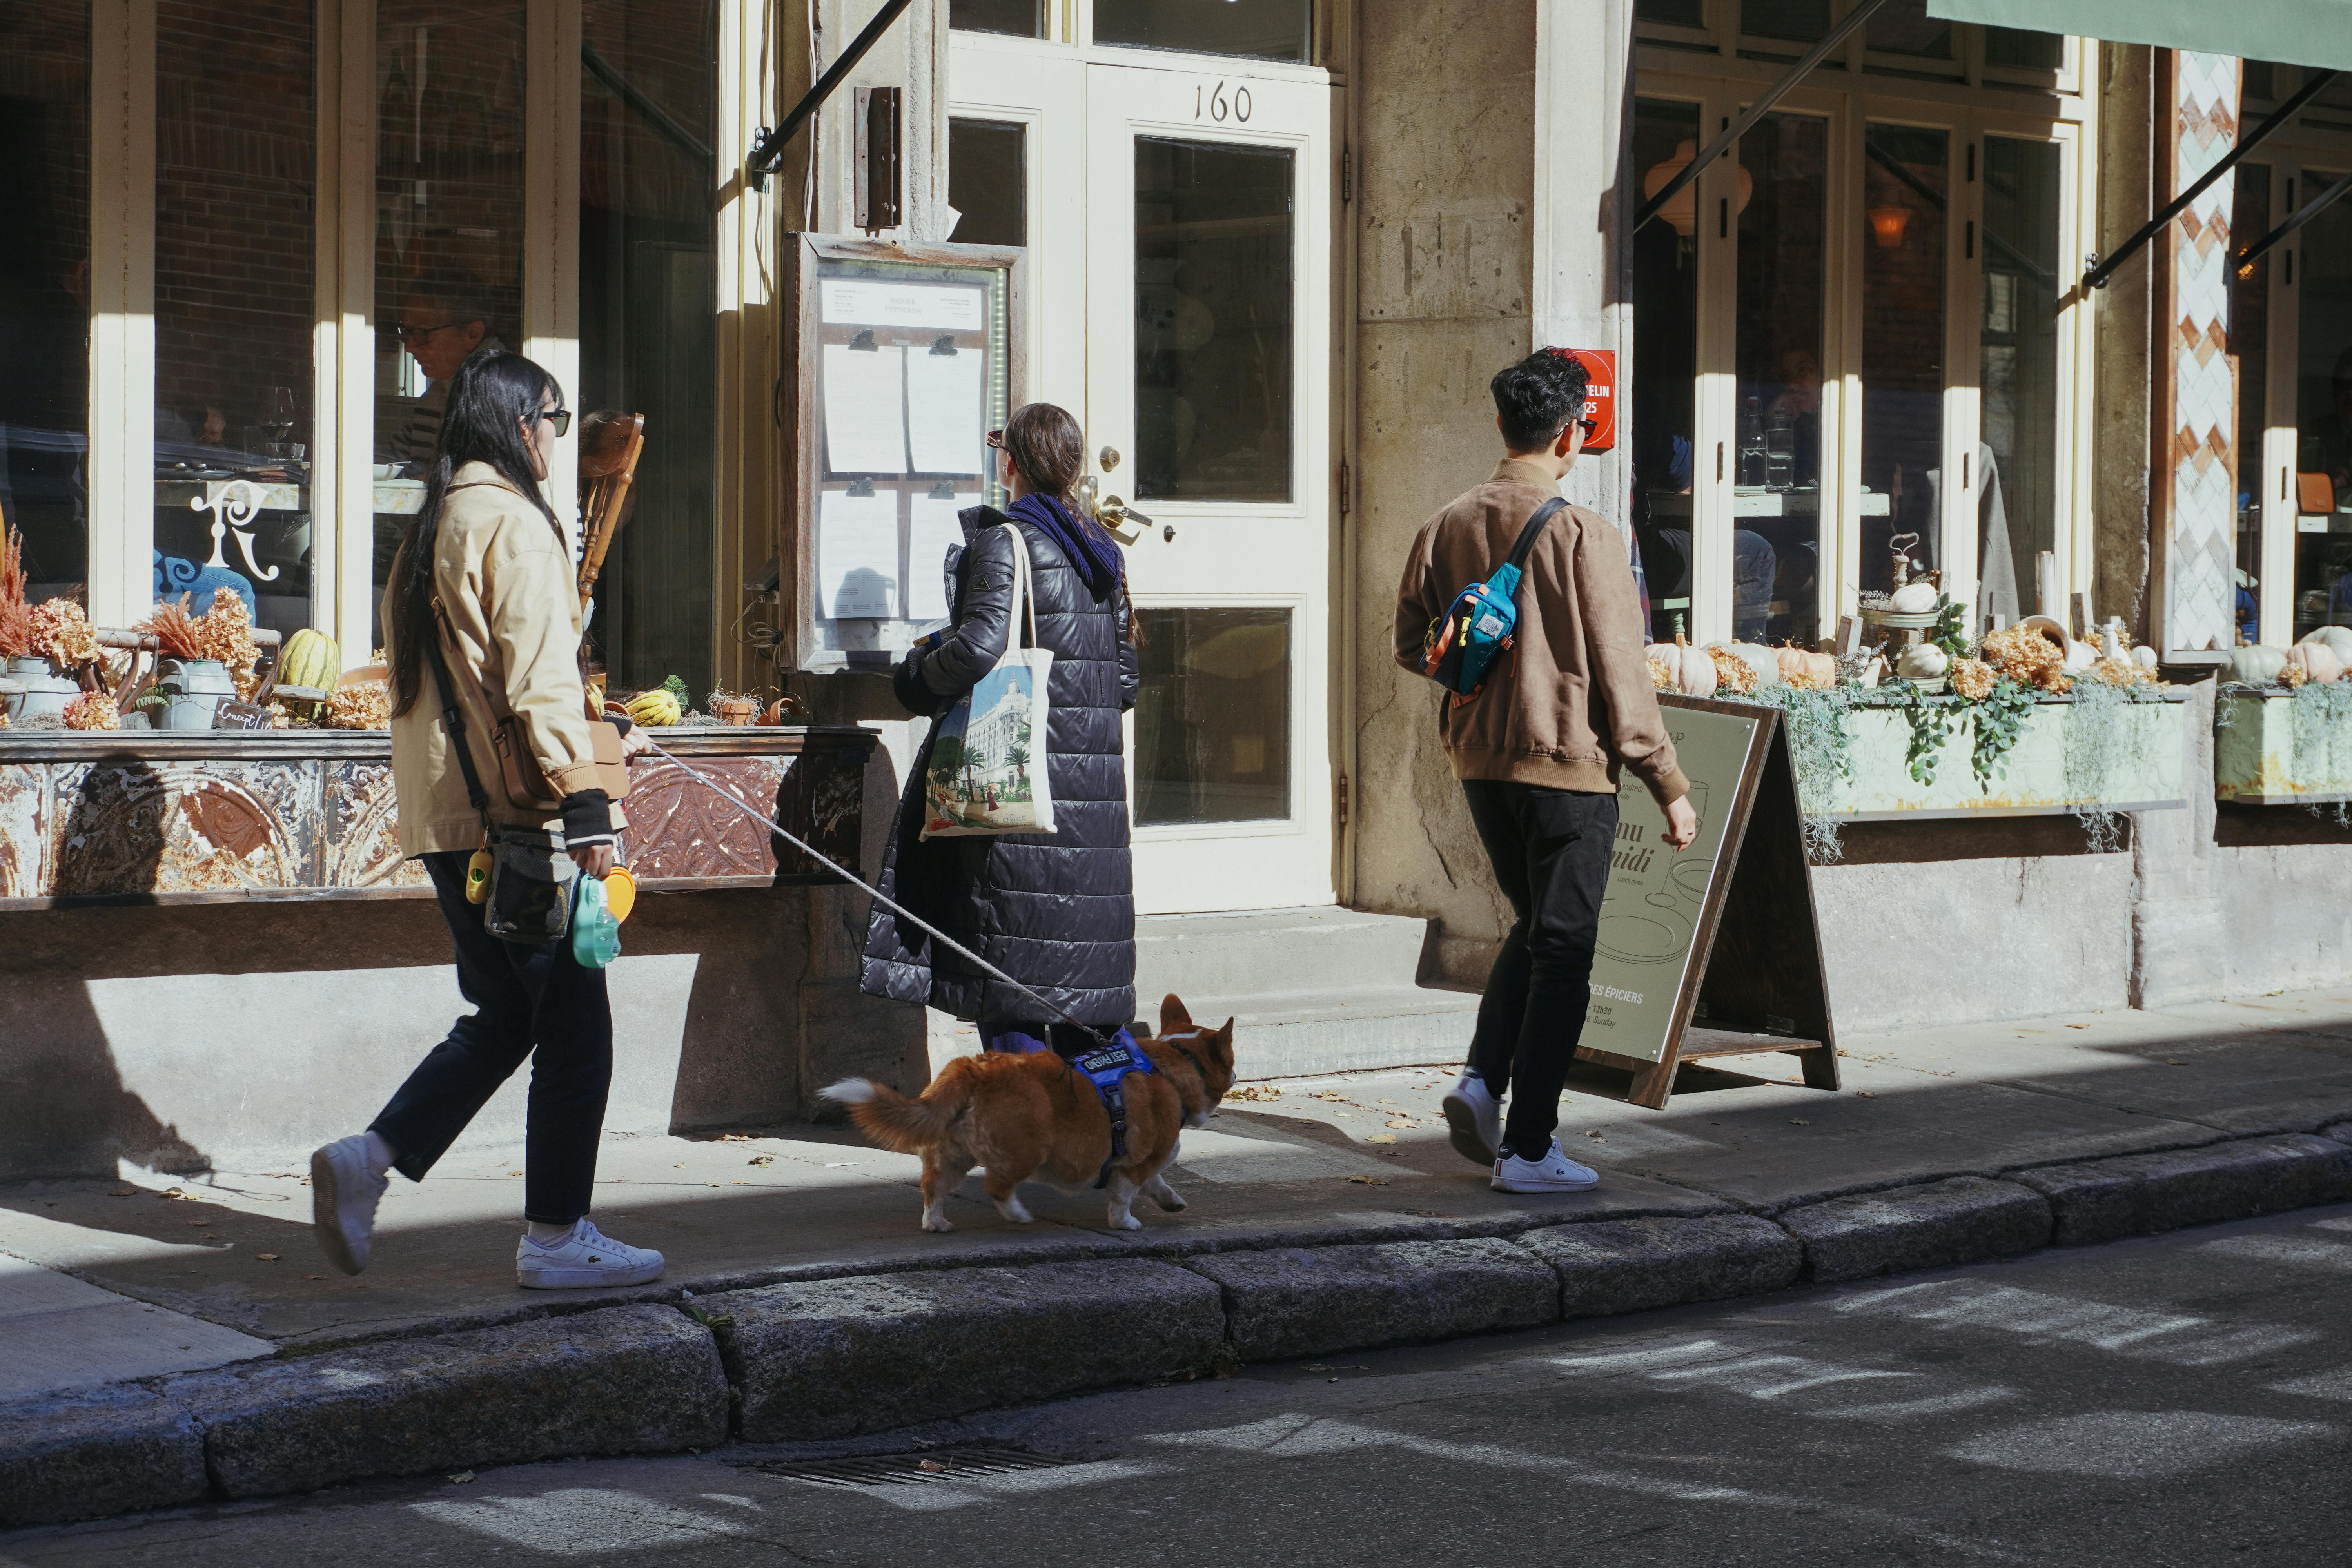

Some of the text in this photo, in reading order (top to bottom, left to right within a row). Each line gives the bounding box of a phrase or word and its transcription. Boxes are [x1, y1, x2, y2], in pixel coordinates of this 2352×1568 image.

[1195, 80, 1251, 122] 160
[884, 305, 922, 314] PETTIGREW
[1586, 385, 1609, 397] ELIN
[1584, 401, 1597, 413] 25
[191, 479, 279, 581] R
[218, 702, 256, 730] Concept
[1622, 783, 1644, 793] endredi
[1615, 822, 1644, 842] nu
[1589, 983, 1644, 1004] DES ÉPICIERS
[1593, 1005, 1612, 1015] 13h30
[1593, 1016, 1617, 1029] Sunday
[1084, 1050, 1129, 1069] BEST FRIEND
